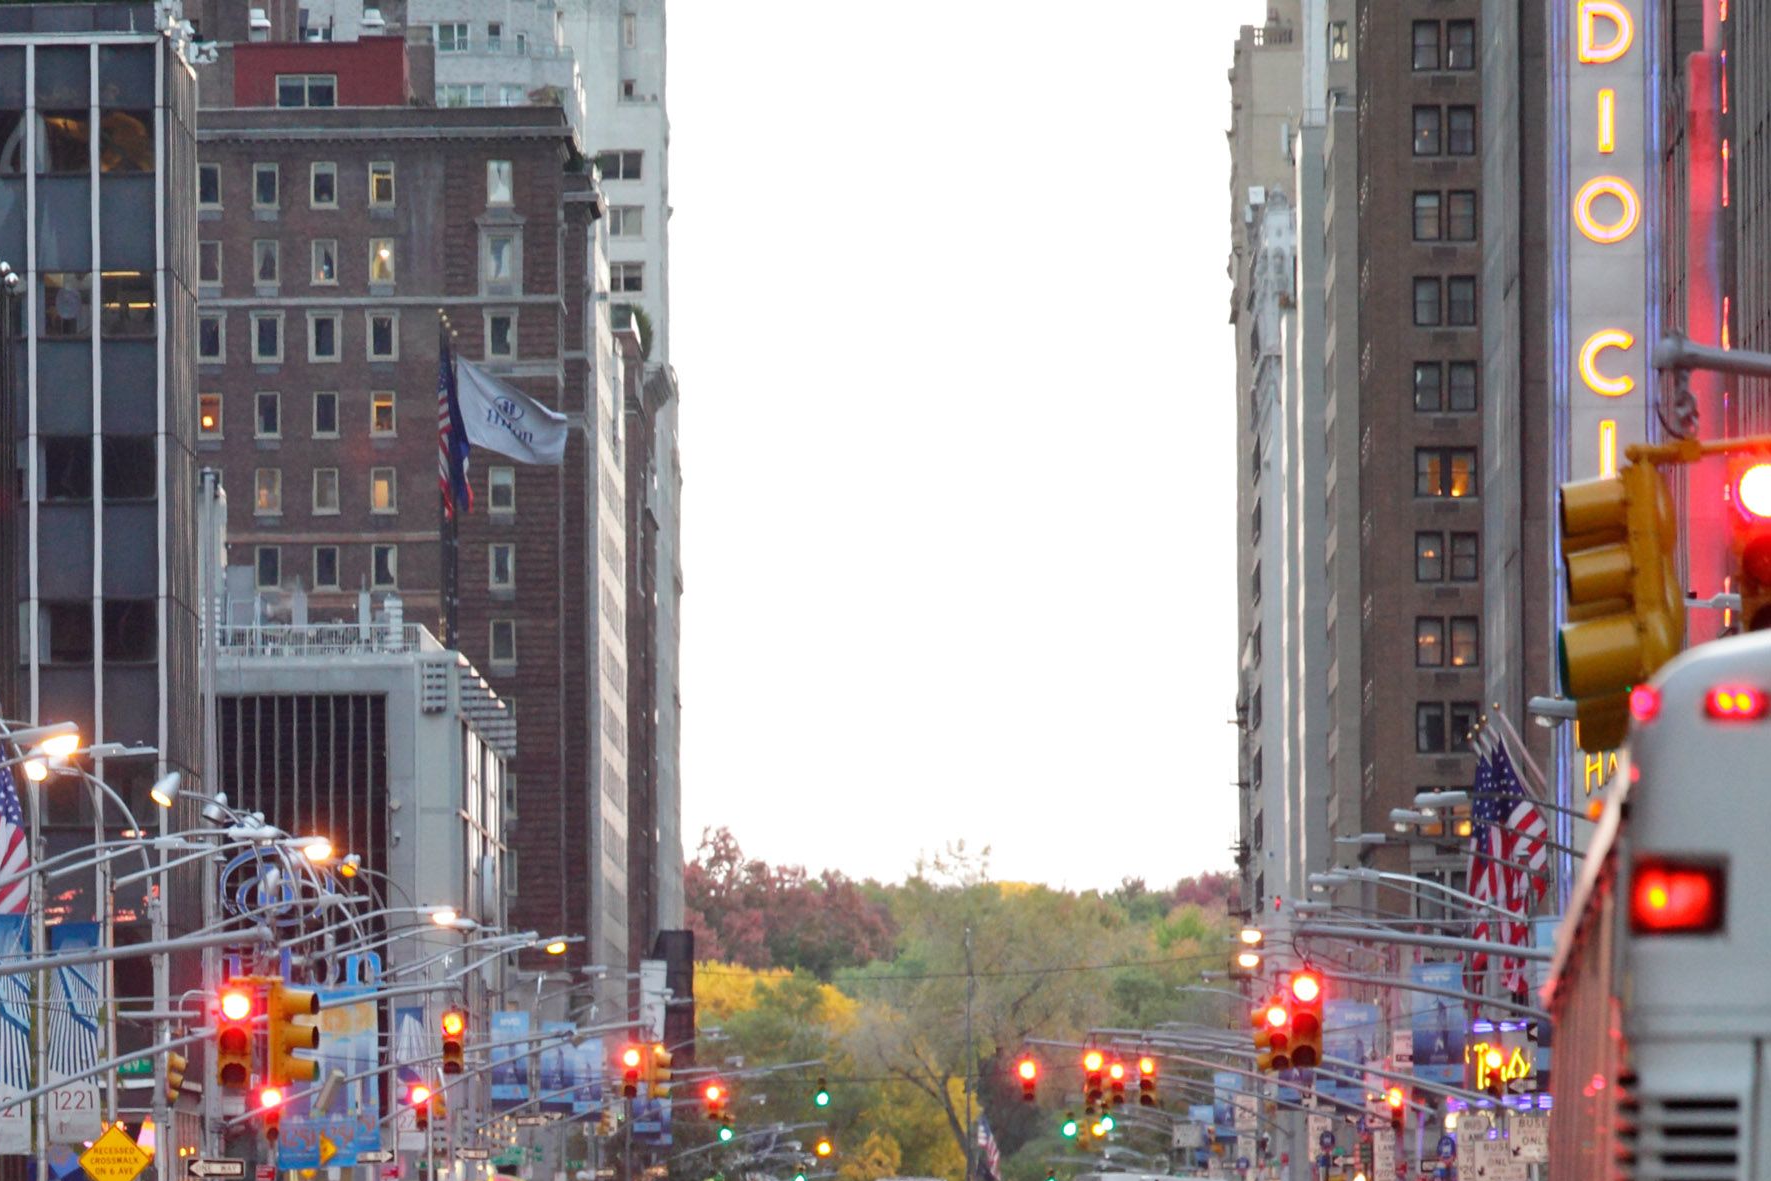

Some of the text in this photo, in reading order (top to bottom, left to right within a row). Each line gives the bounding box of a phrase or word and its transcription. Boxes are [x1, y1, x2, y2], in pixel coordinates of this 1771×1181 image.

[1578, 328, 1635, 480] CI
[53, 1090, 95, 1111] 1221
[1519, 1118, 1549, 1129] BUSE
[1521, 1136, 1545, 1147] ONL
[93, 1147, 136, 1155] RECESSED
[90, 1156, 140, 1165] CROSSWALK
[94, 1168, 134, 1176] ON 6 AVE
[196, 1163, 238, 1174] ONE WAY
